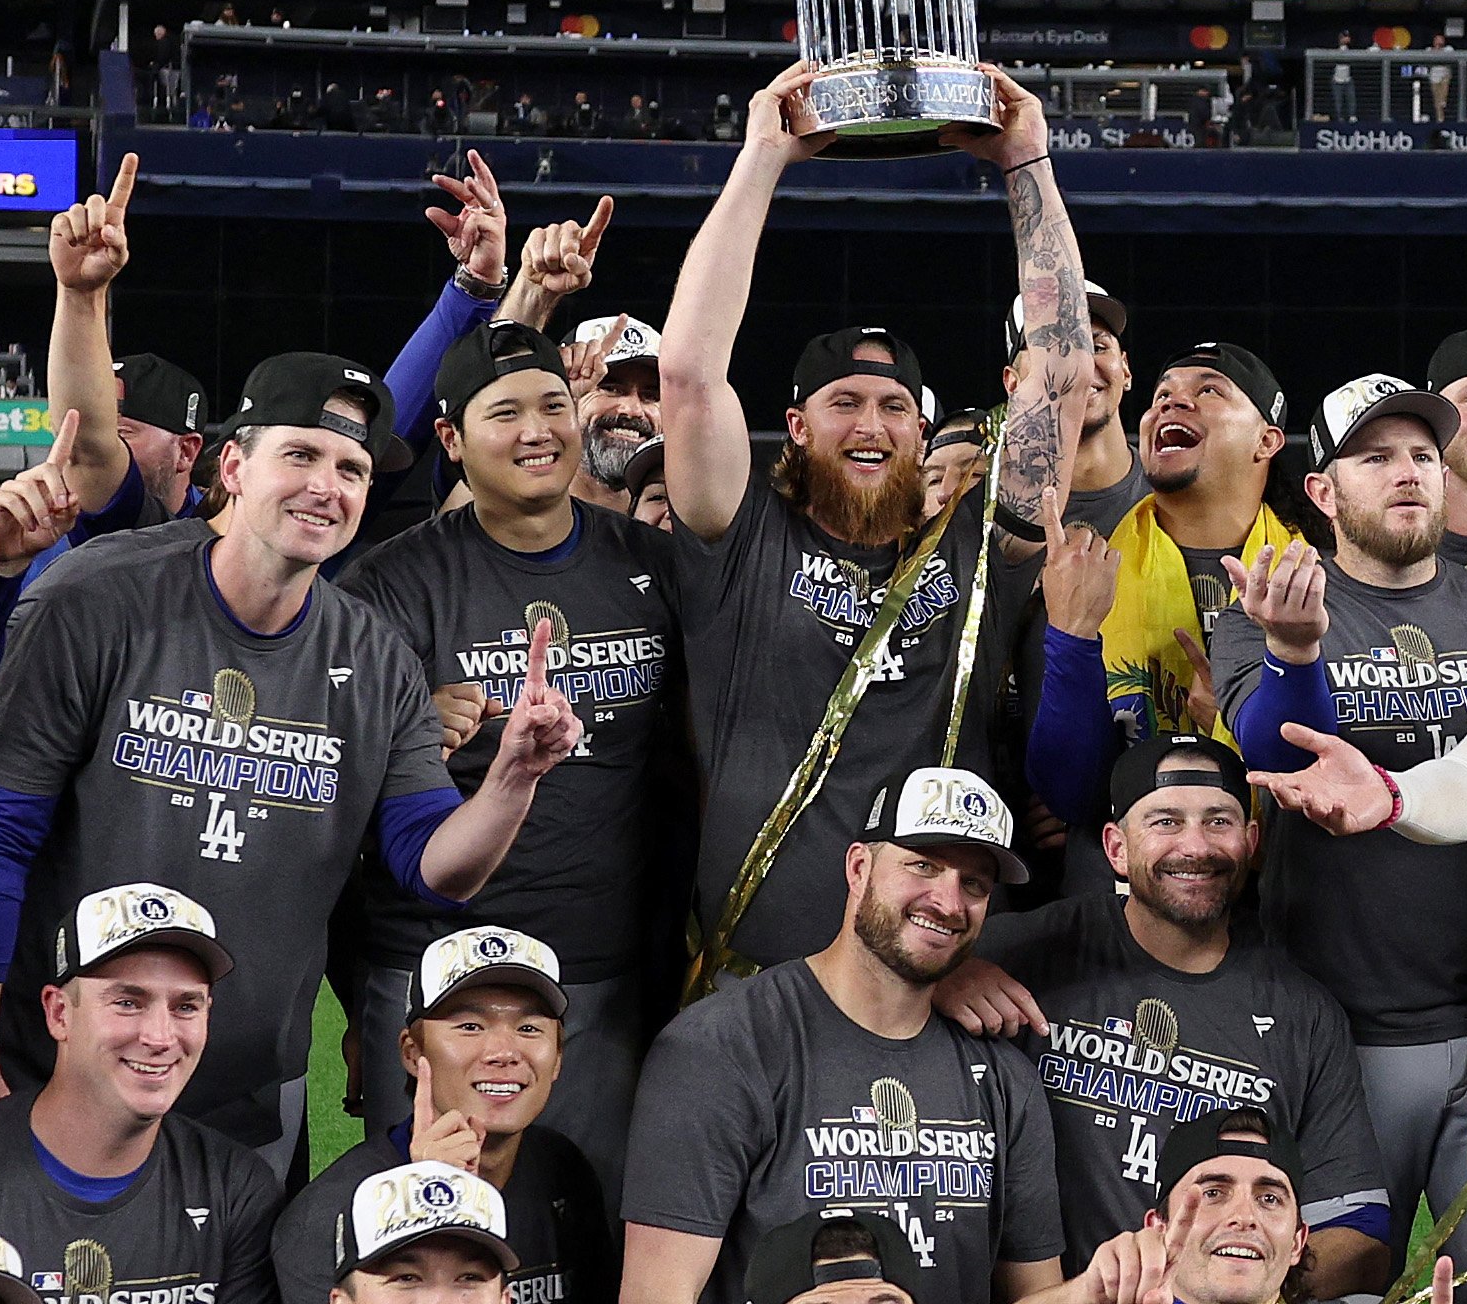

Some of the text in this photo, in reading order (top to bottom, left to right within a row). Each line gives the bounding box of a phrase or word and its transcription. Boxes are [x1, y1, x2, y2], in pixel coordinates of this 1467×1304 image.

[1316, 128, 1413, 151] StubHub
[128, 699, 345, 765] WORLD SERIES
[112, 732, 339, 804] CHAMPIONS
[170, 793, 269, 821] 20 24
[805, 1127, 916, 1159] WORLD
[805, 1159, 995, 1199] CHAMPIONS
